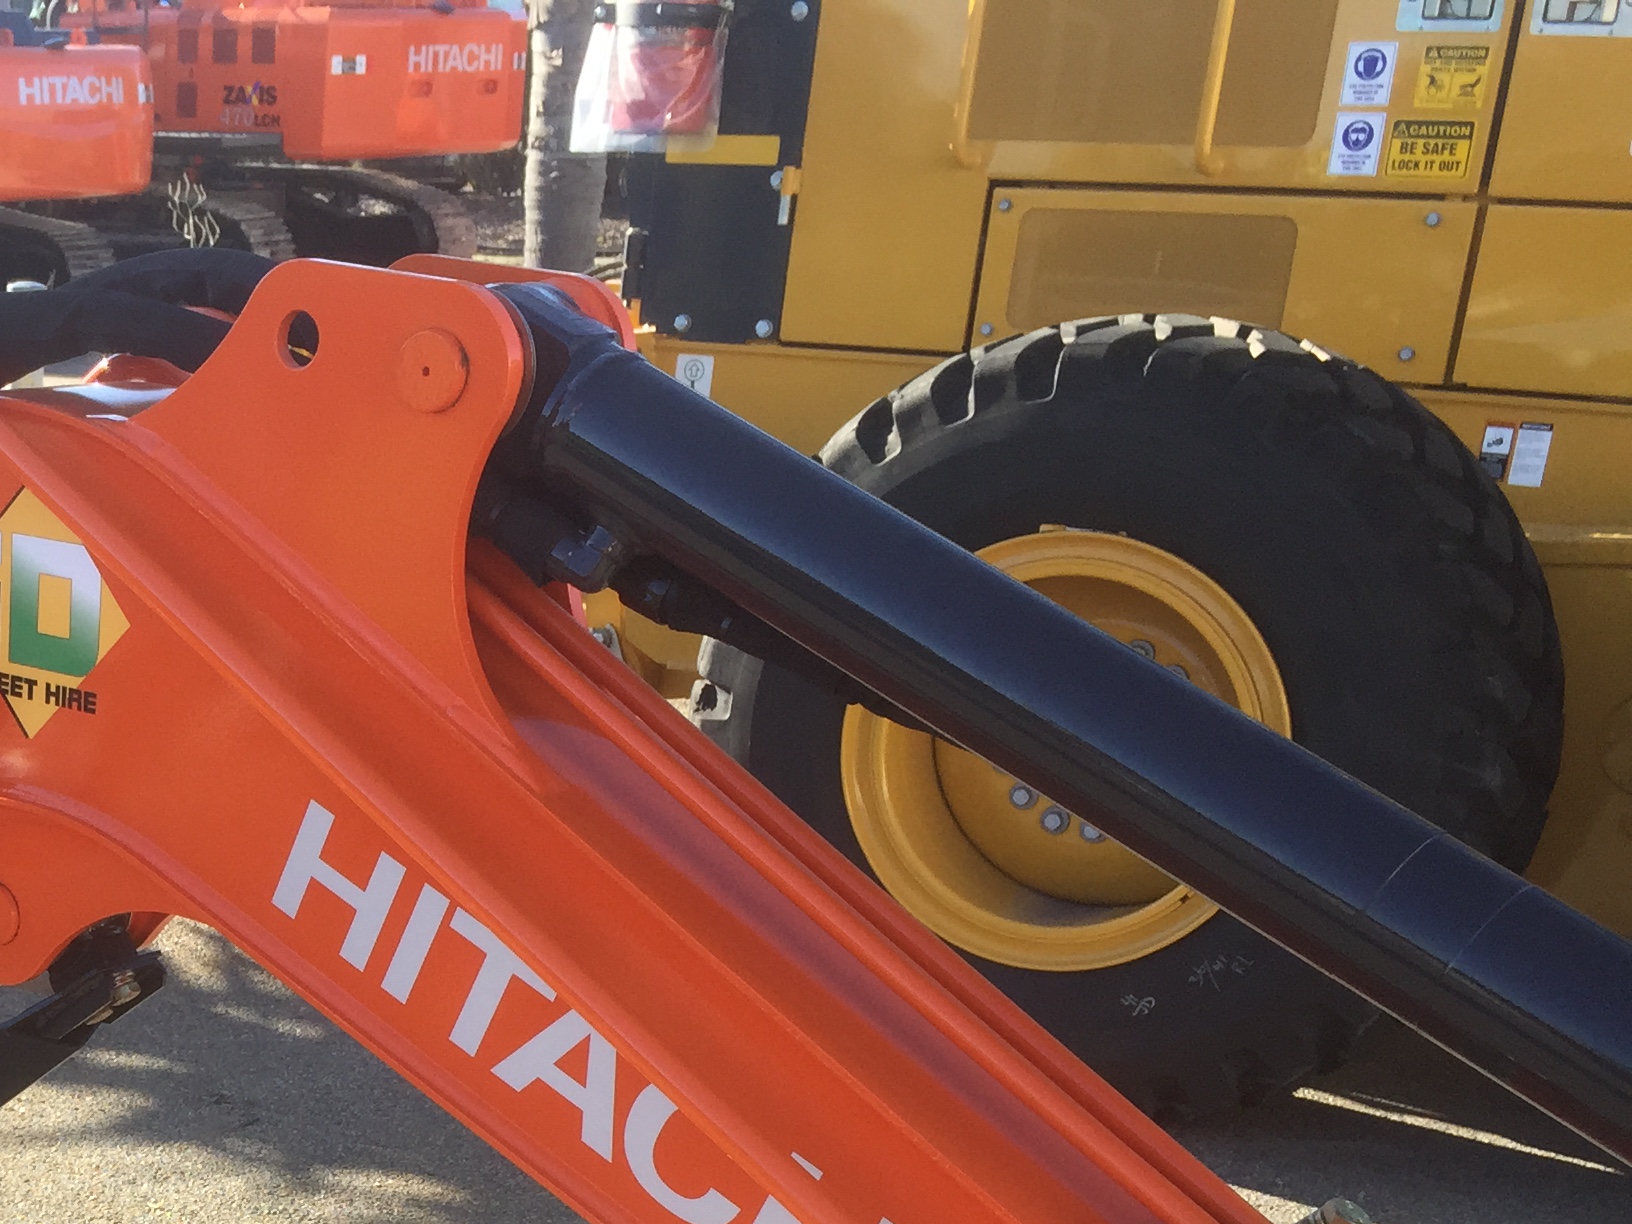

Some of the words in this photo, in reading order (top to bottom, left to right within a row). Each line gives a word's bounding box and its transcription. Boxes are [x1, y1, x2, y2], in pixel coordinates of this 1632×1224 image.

[407, 43, 504, 73] HITACHI
[18, 76, 124, 105] HITACHI
[223, 81, 277, 106] ZAXIS
[1409, 124, 1471, 138] CAUTION
[1399, 141, 1418, 156] BE
[1421, 141, 1459, 157] SAFE
[1391, 159, 1420, 172] LOCK
[1423, 160, 1436, 172] IT
[1438, 160, 1462, 173] OUT
[44, 681, 98, 715] HIRE
